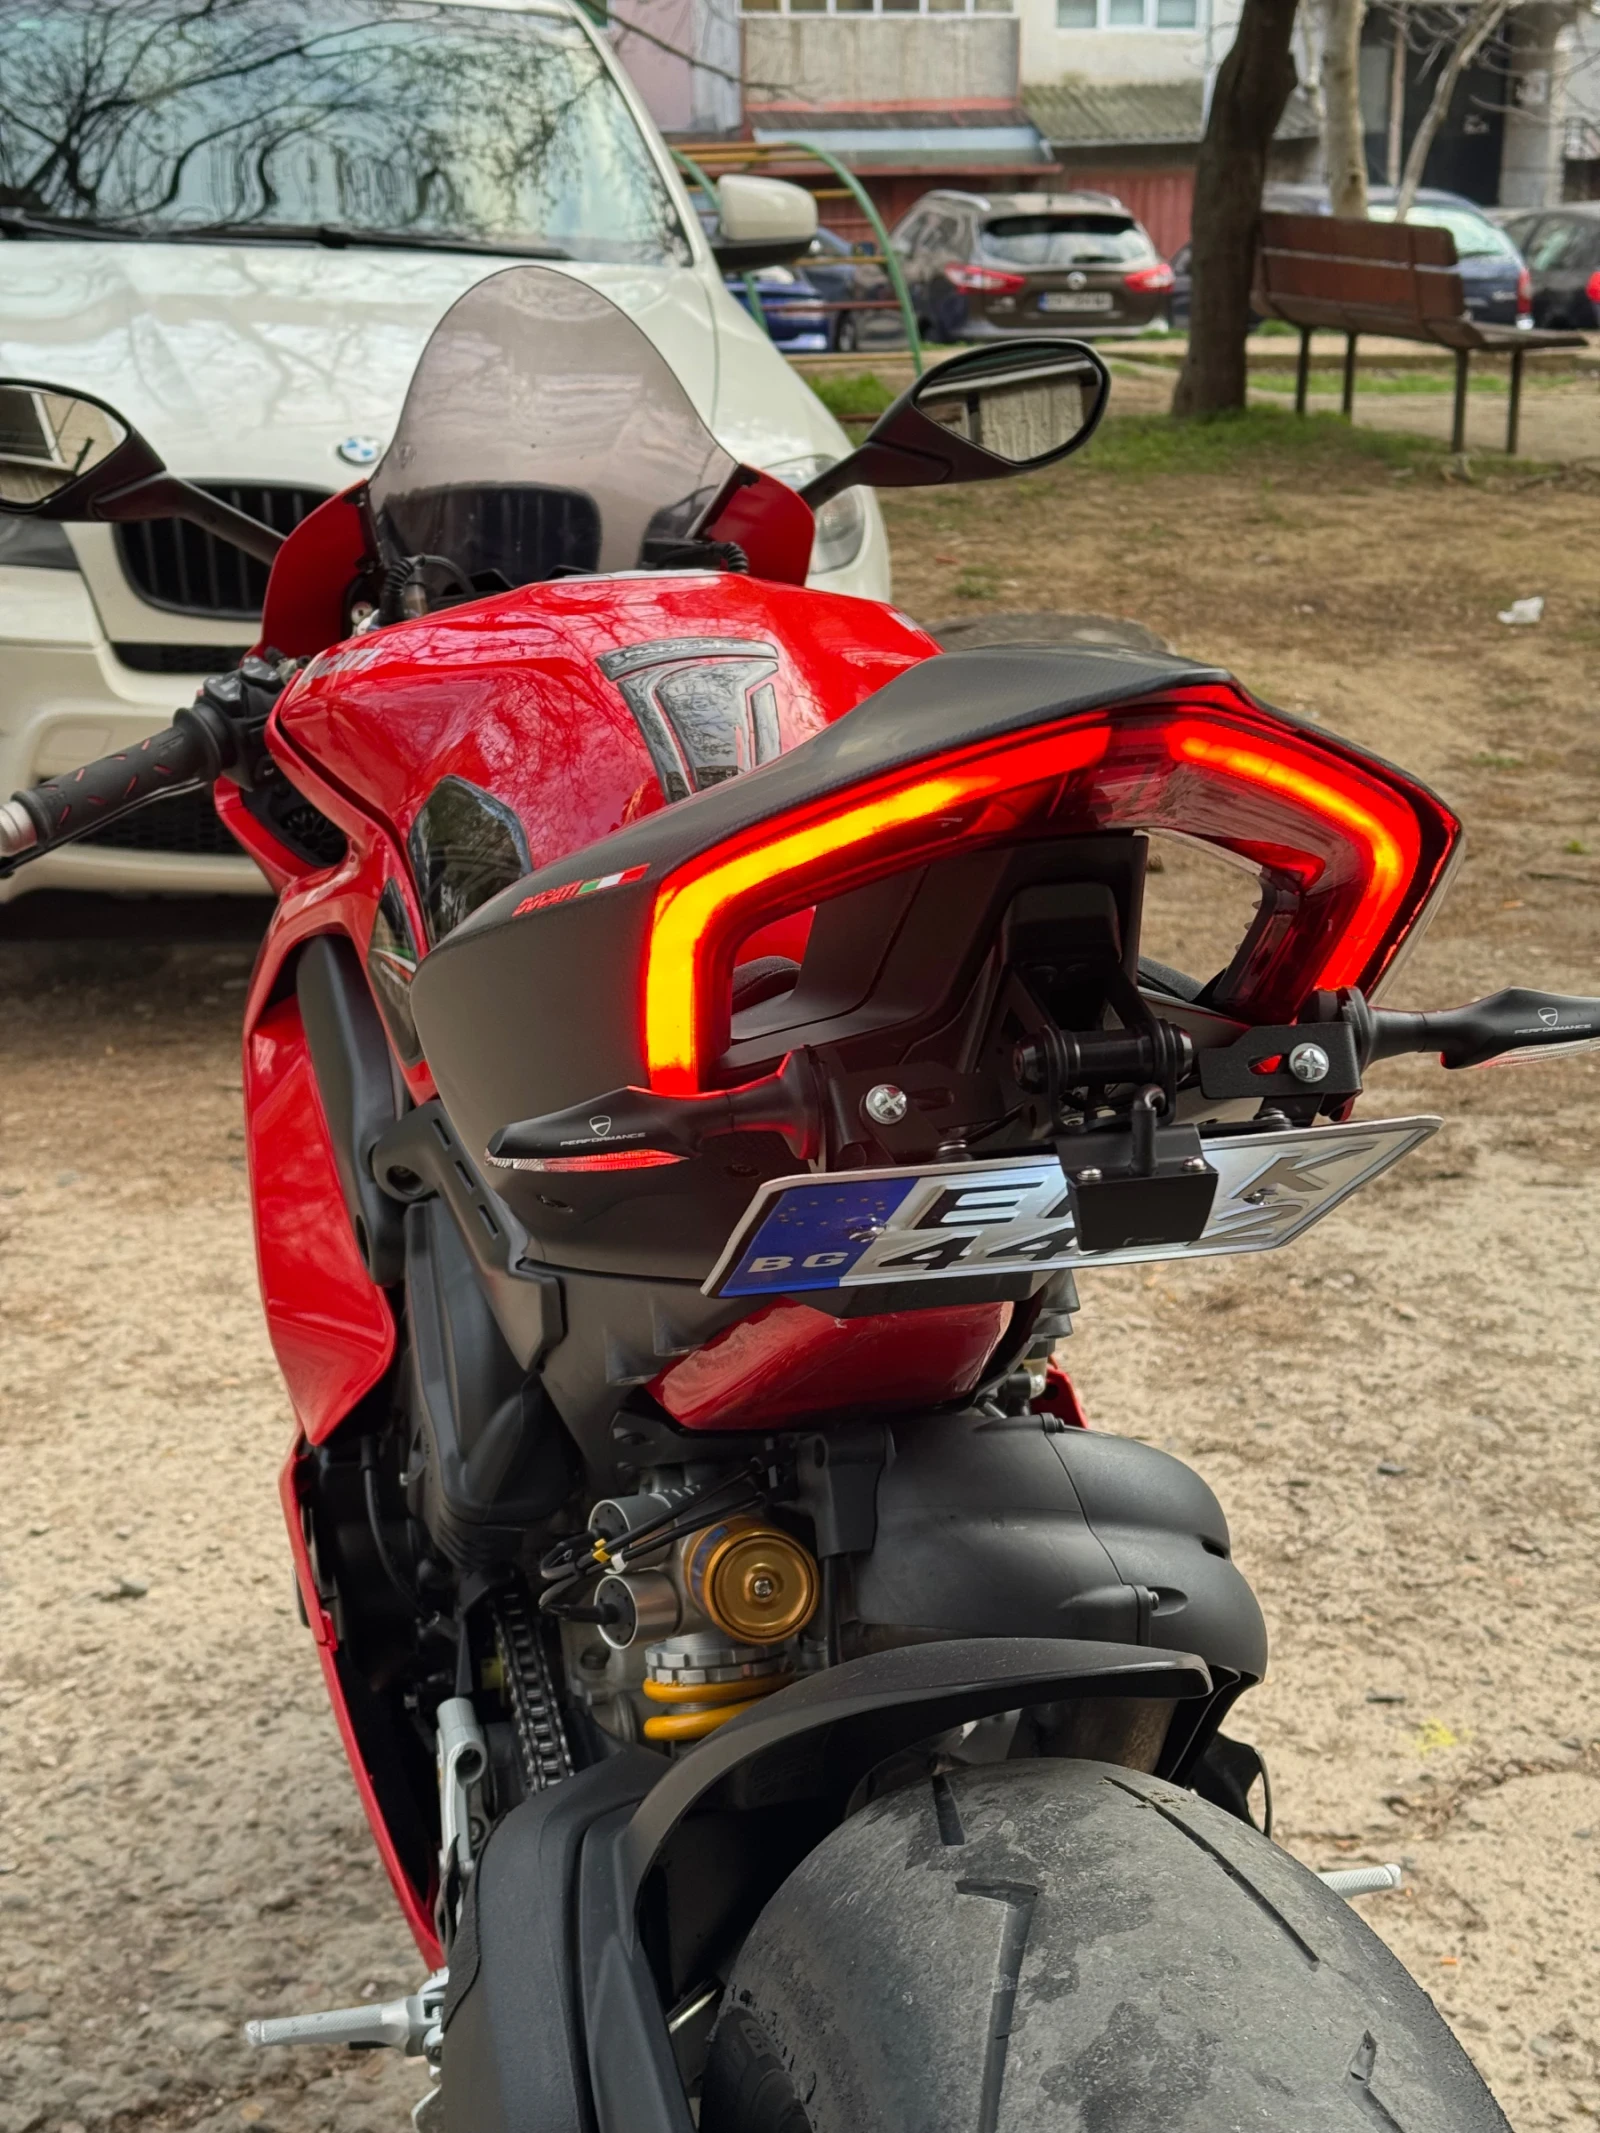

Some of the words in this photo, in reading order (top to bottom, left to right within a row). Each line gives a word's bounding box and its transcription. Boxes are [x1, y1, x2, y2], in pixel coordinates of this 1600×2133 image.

[511, 879, 585, 918] DUCATI
[1514, 1023, 1592, 1035] PERFORMANCE
[559, 1131, 647, 1147] PERFORMANCE
[1229, 1143, 1377, 1201] K
[747, 1251, 849, 1273] BG
